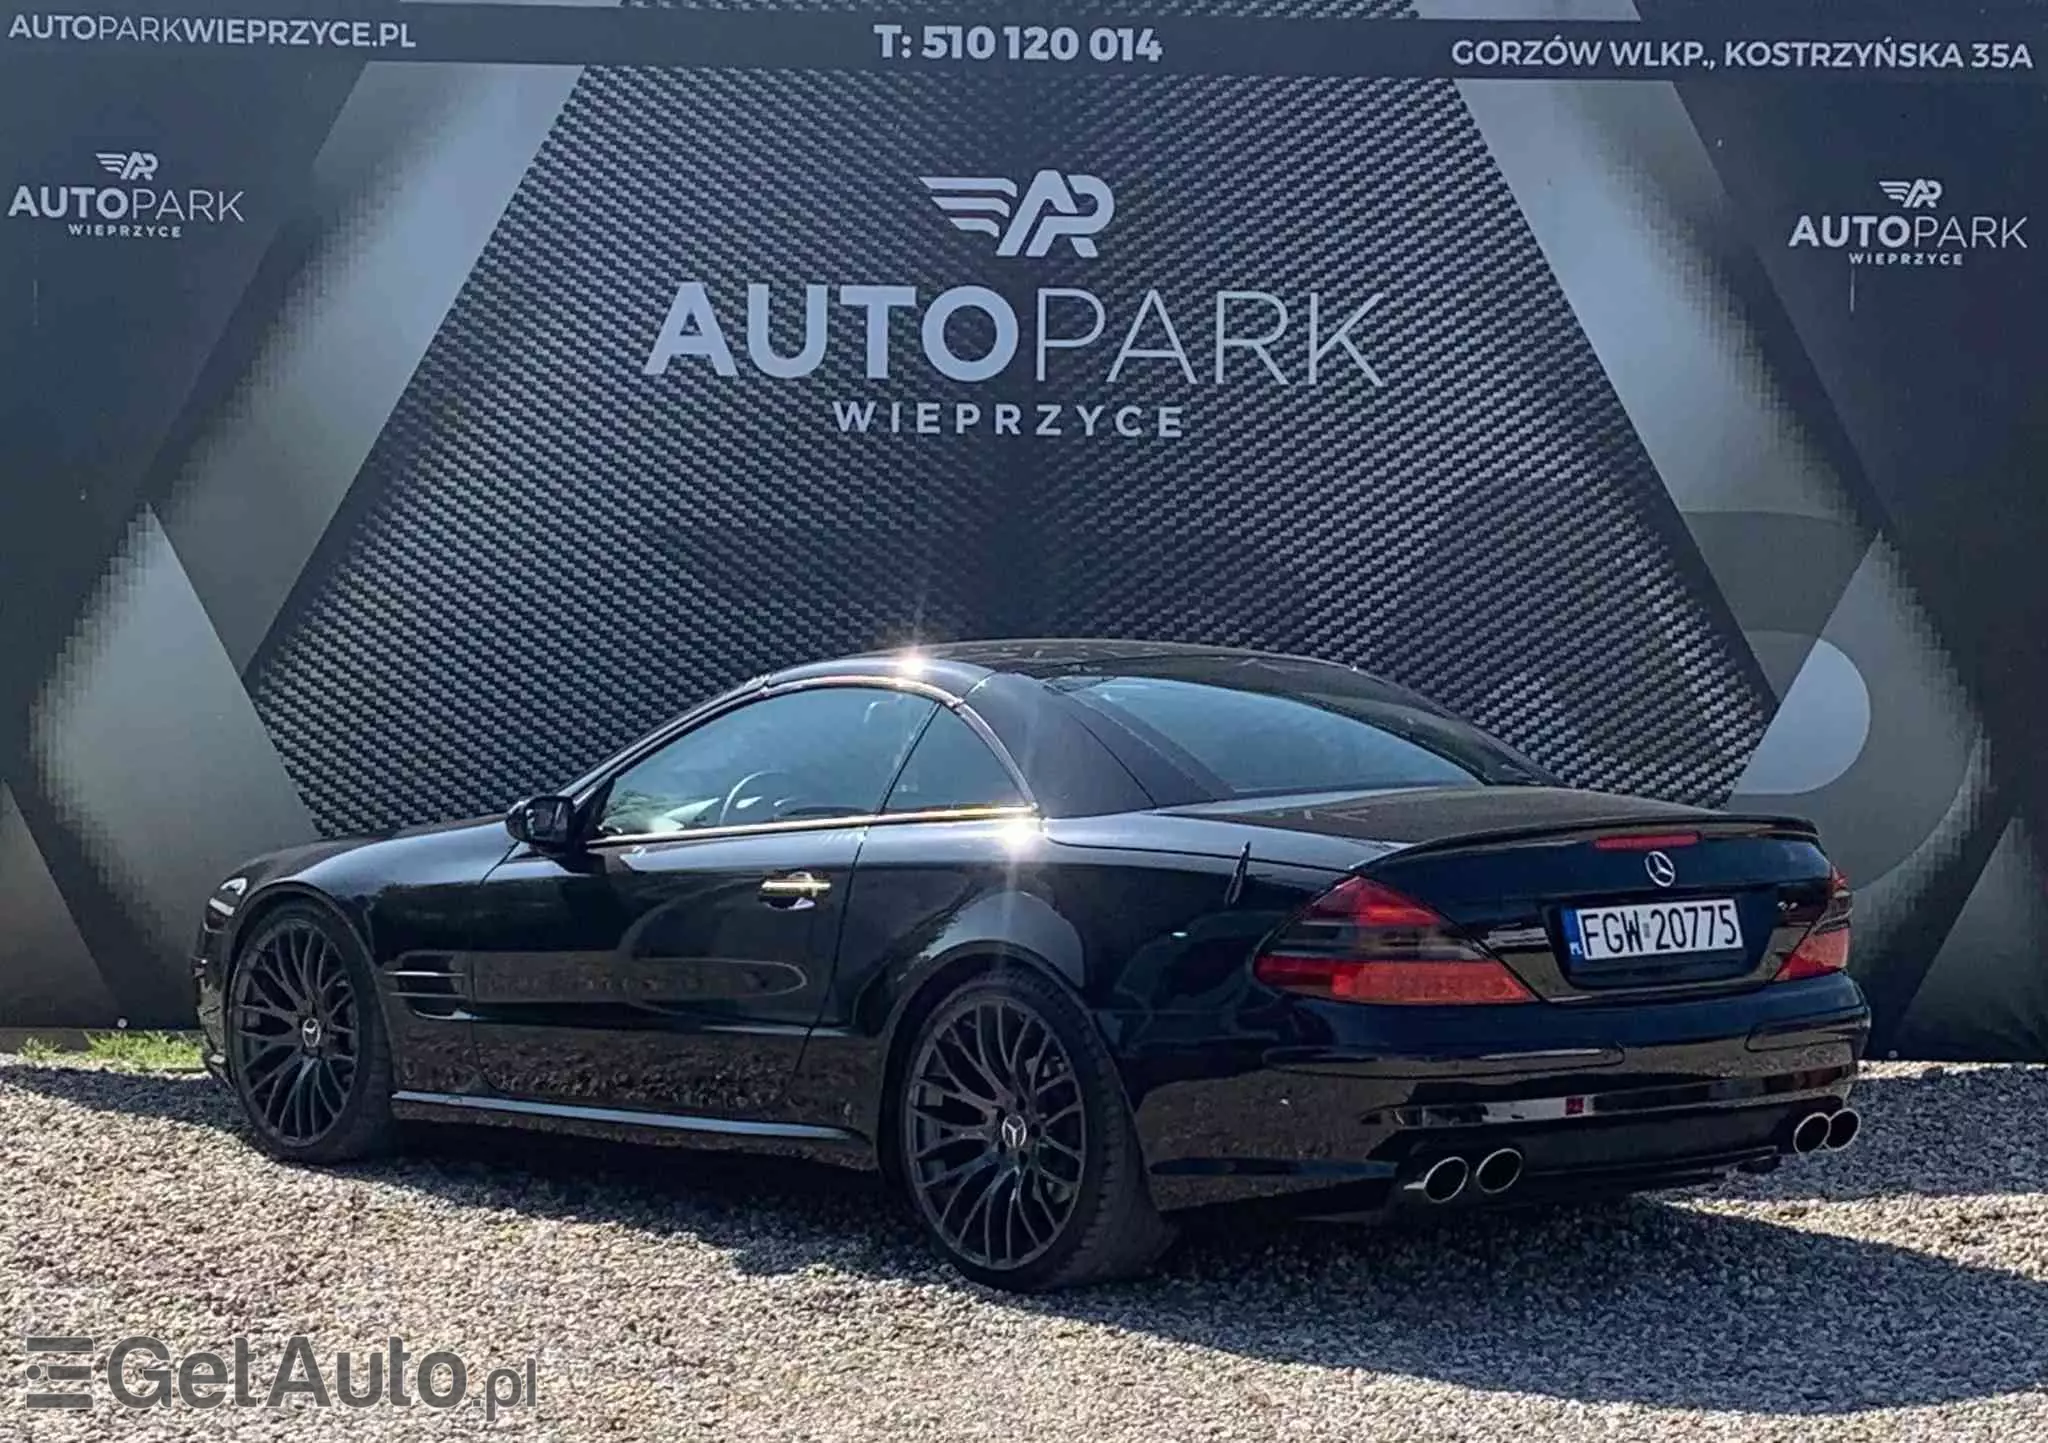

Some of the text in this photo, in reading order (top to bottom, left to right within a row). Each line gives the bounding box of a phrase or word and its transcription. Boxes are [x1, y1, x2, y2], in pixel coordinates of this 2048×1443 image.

[8, 14, 416, 48] AUTOPARKWIEPRZYCE.PL
[873, 25, 1163, 61] T: 510 120 014
[1451, 35, 2033, 70] GORZÓW WLKP., KOSTRZYŃSKA 35A
[8, 186, 245, 223] AUTOPARK
[68, 224, 182, 238] WIEPRZYCE
[1788, 215, 2029, 249] AUTOPARK
[1849, 252, 1963, 266] WIEPRZYCE
[644, 282, 1383, 388] AUTOPARK
[832, 401, 1183, 438] WIEPRZYCE
[1581, 905, 1737, 956] FGW 20775
